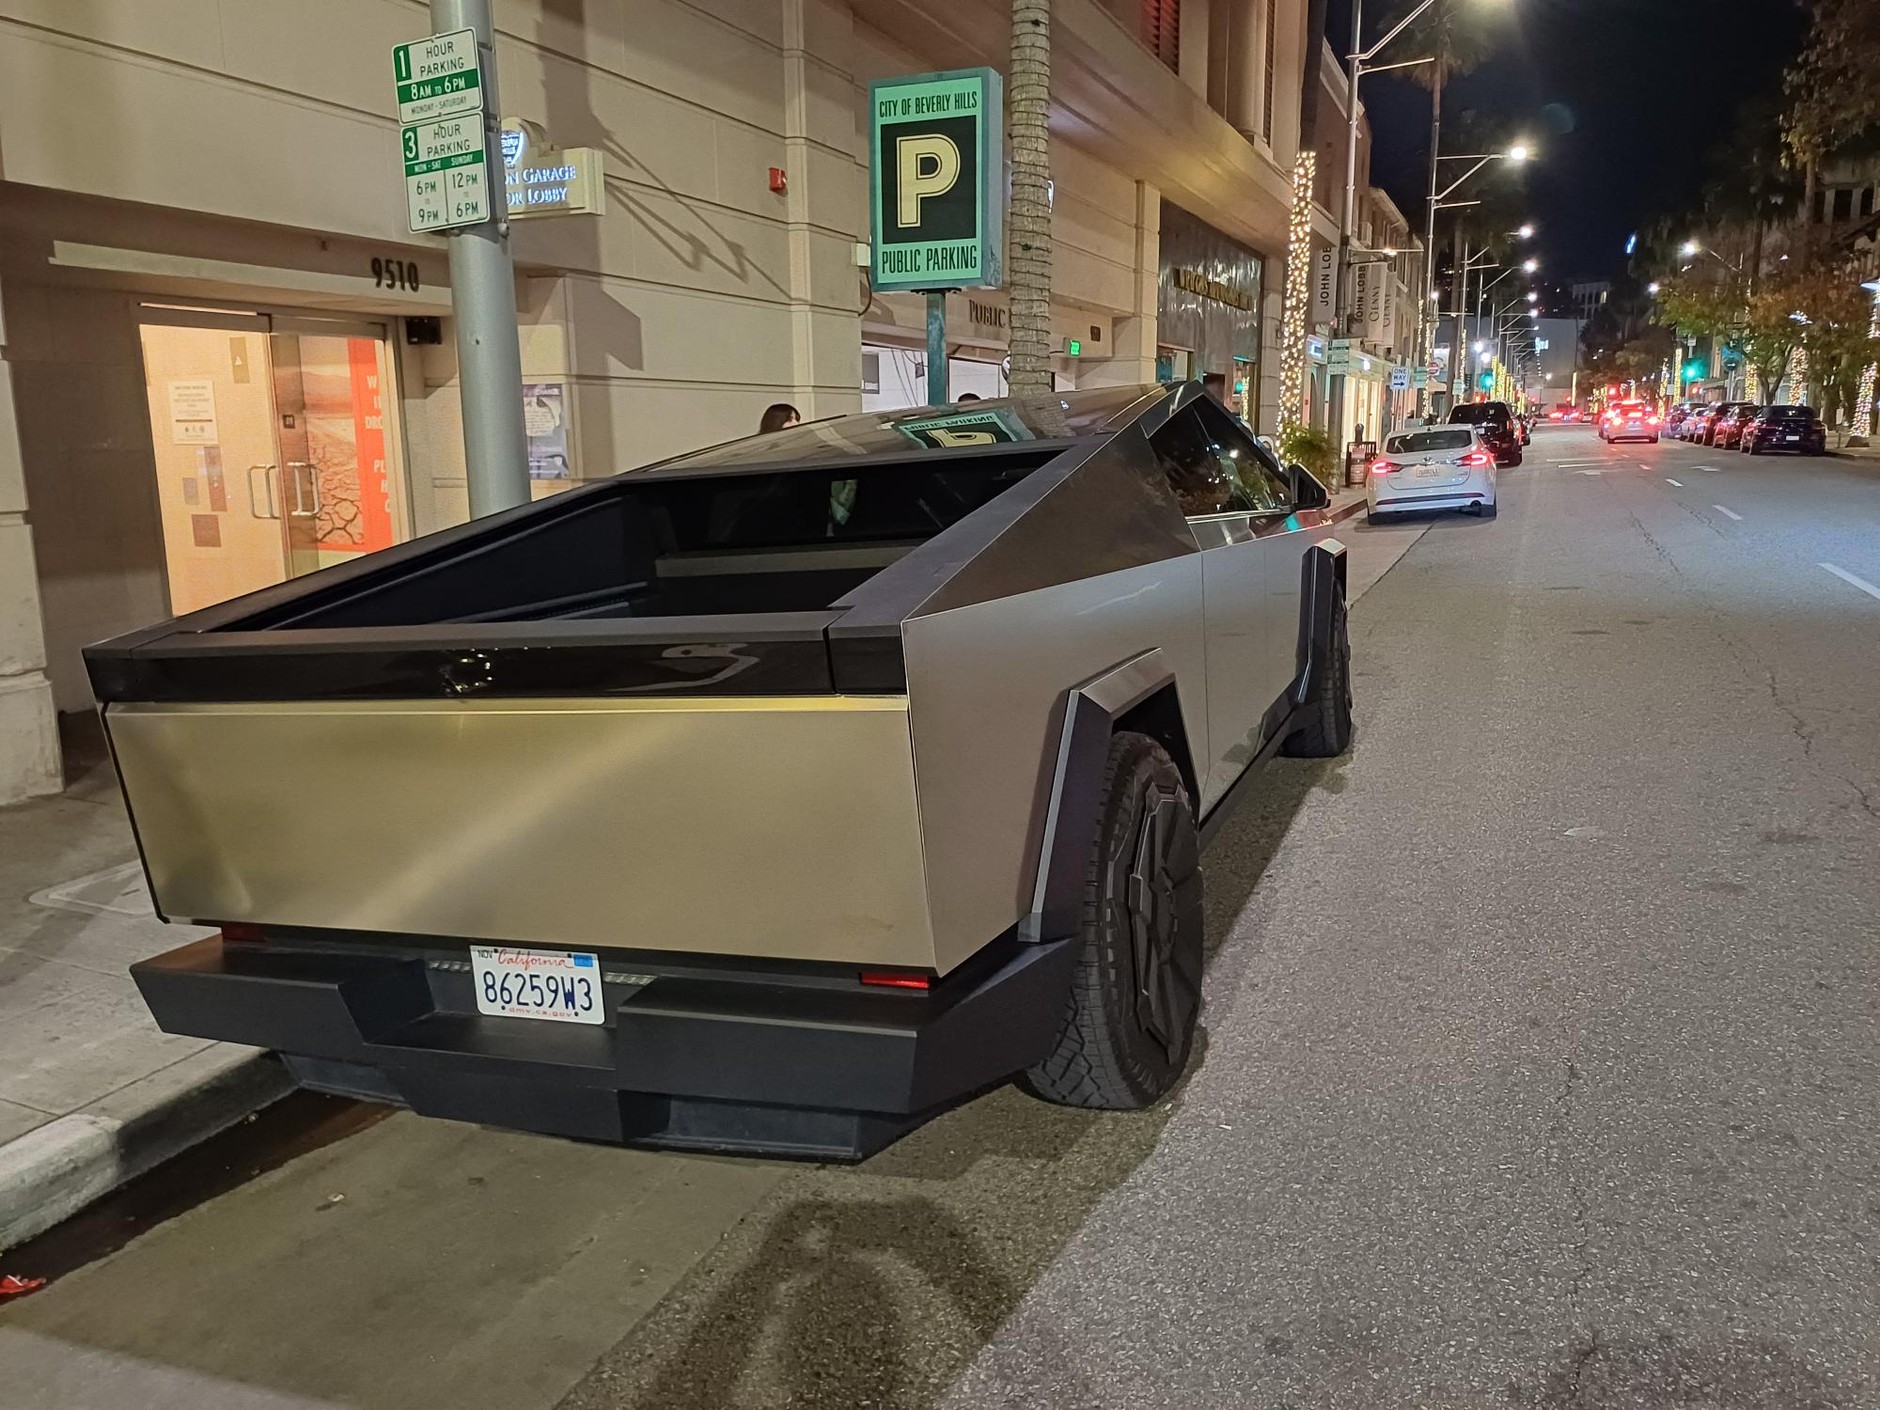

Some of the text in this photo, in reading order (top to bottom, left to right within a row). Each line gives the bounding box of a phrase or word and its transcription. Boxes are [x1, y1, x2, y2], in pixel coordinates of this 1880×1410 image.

[399, 50, 406, 77] 1
[426, 42, 454, 59] HOUR
[420, 57, 464, 78] PARKING
[880, 91, 977, 118] CITY OF BEVERLY HILLS
[404, 131, 416, 159] 3
[434, 124, 461, 140] HOUR
[427, 139, 470, 157] PARKING
[451, 154, 473, 166] SUNDAY
[522, 166, 576, 184] GARAGE
[897, 134, 961, 228] P
[527, 188, 567, 204] LOBBY
[882, 245, 977, 274] PUBLIC PARKING
[371, 257, 419, 292] 9510
[1358, 266, 1366, 293] LOBB
[1320, 274, 1330, 306] JOHN
[969, 299, 1006, 329] PUBLIC
[477, 950, 493, 959] NOV
[498, 949, 574, 971] California
[483, 970, 593, 1012] 86259W3
[509, 1008, 572, 1017] dmv.ca.gov
